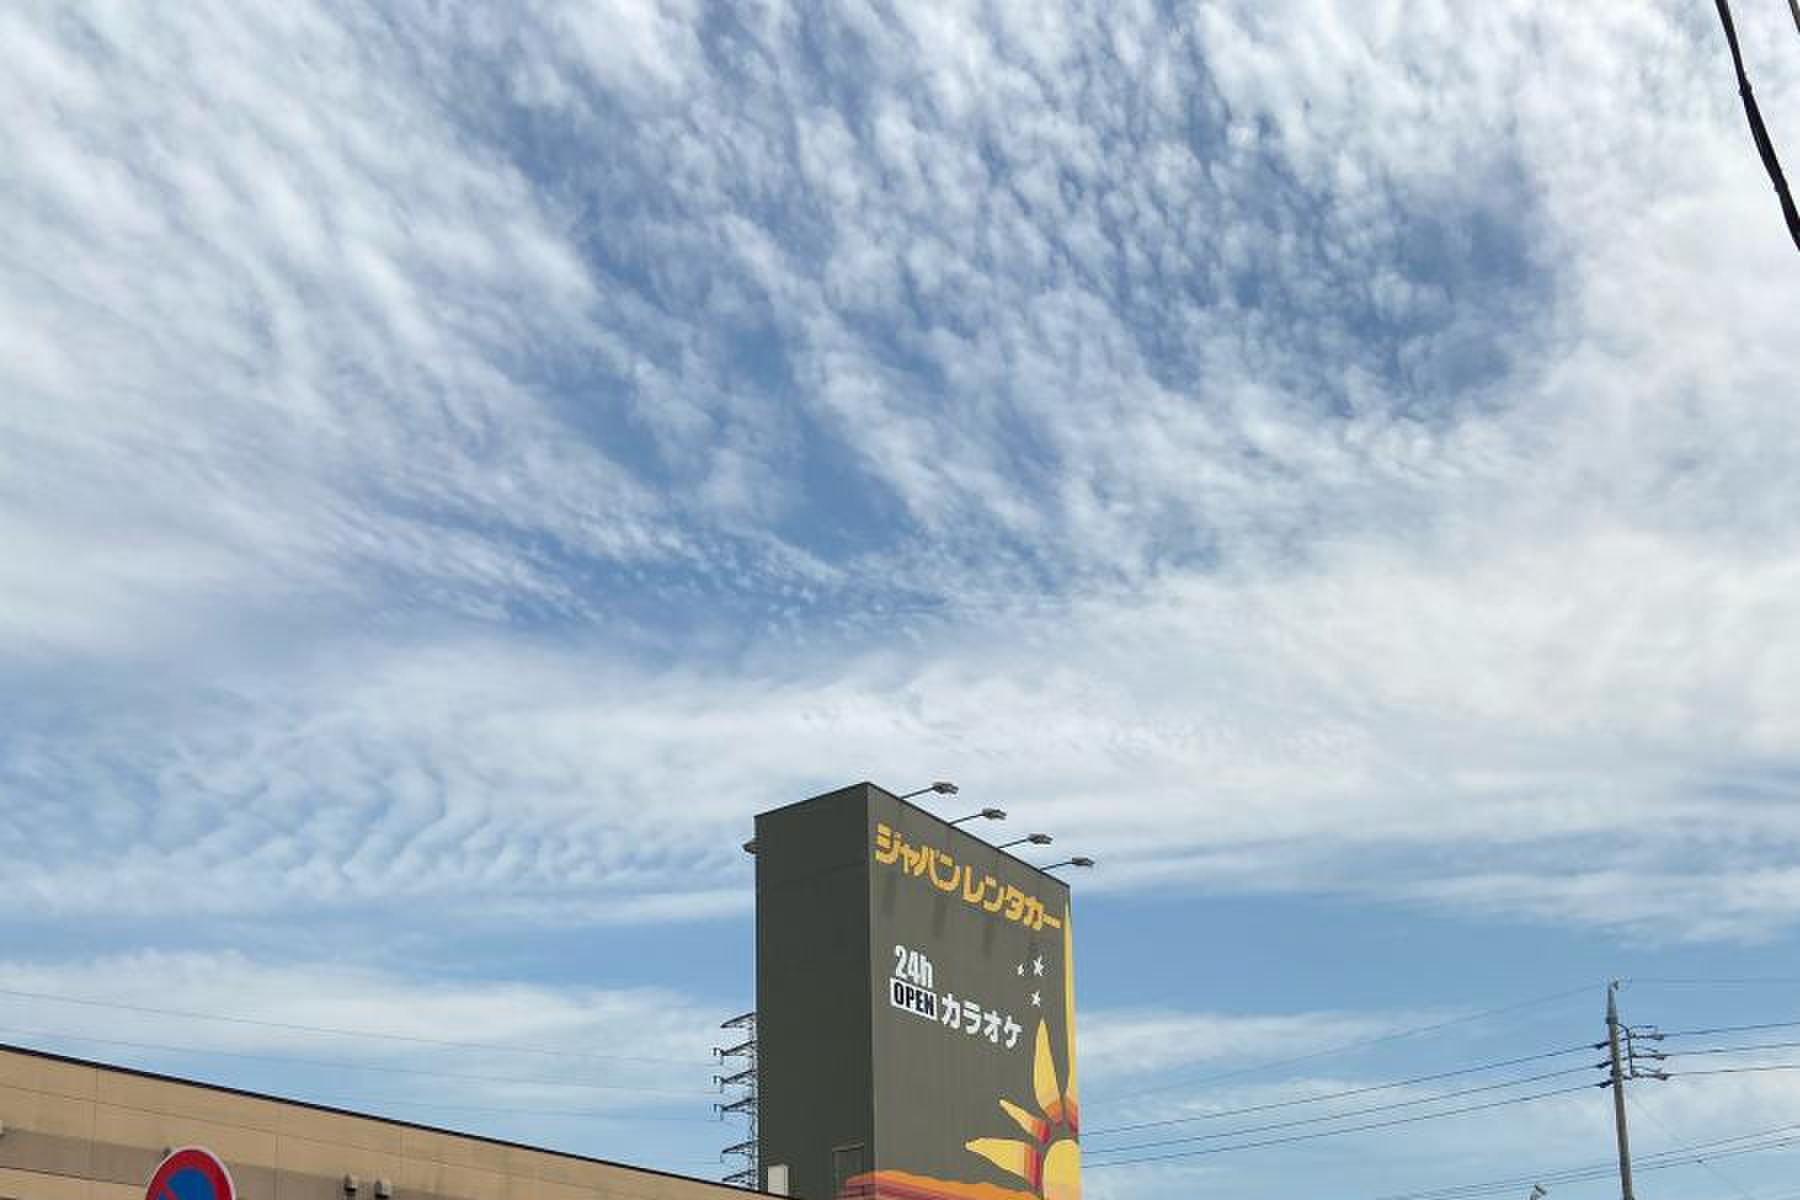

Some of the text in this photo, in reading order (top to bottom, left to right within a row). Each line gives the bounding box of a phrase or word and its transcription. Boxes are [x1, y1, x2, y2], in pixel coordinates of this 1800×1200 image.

[894, 944, 933, 988] 24h
[893, 981, 935, 1017] OPEN
[941, 993, 1023, 1049] カラオケ
